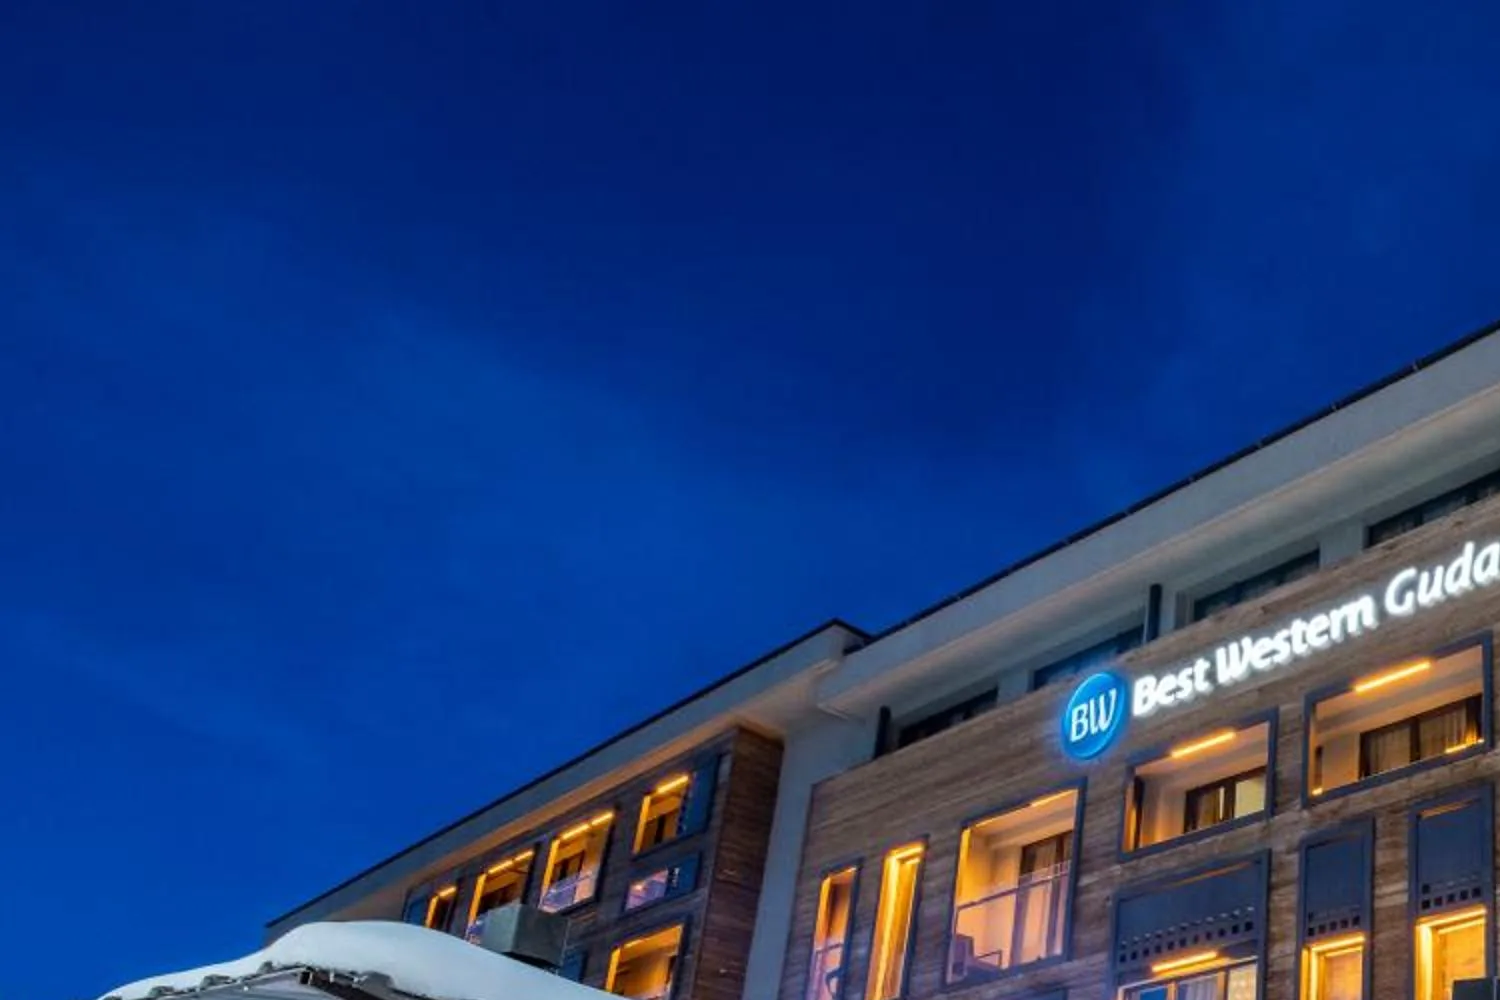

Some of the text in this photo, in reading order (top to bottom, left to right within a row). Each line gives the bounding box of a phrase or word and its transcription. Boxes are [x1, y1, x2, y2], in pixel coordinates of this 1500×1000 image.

[1132, 657, 1212, 717] Best
[1215, 594, 1378, 685] Western
[1070, 687, 1117, 742] BW
